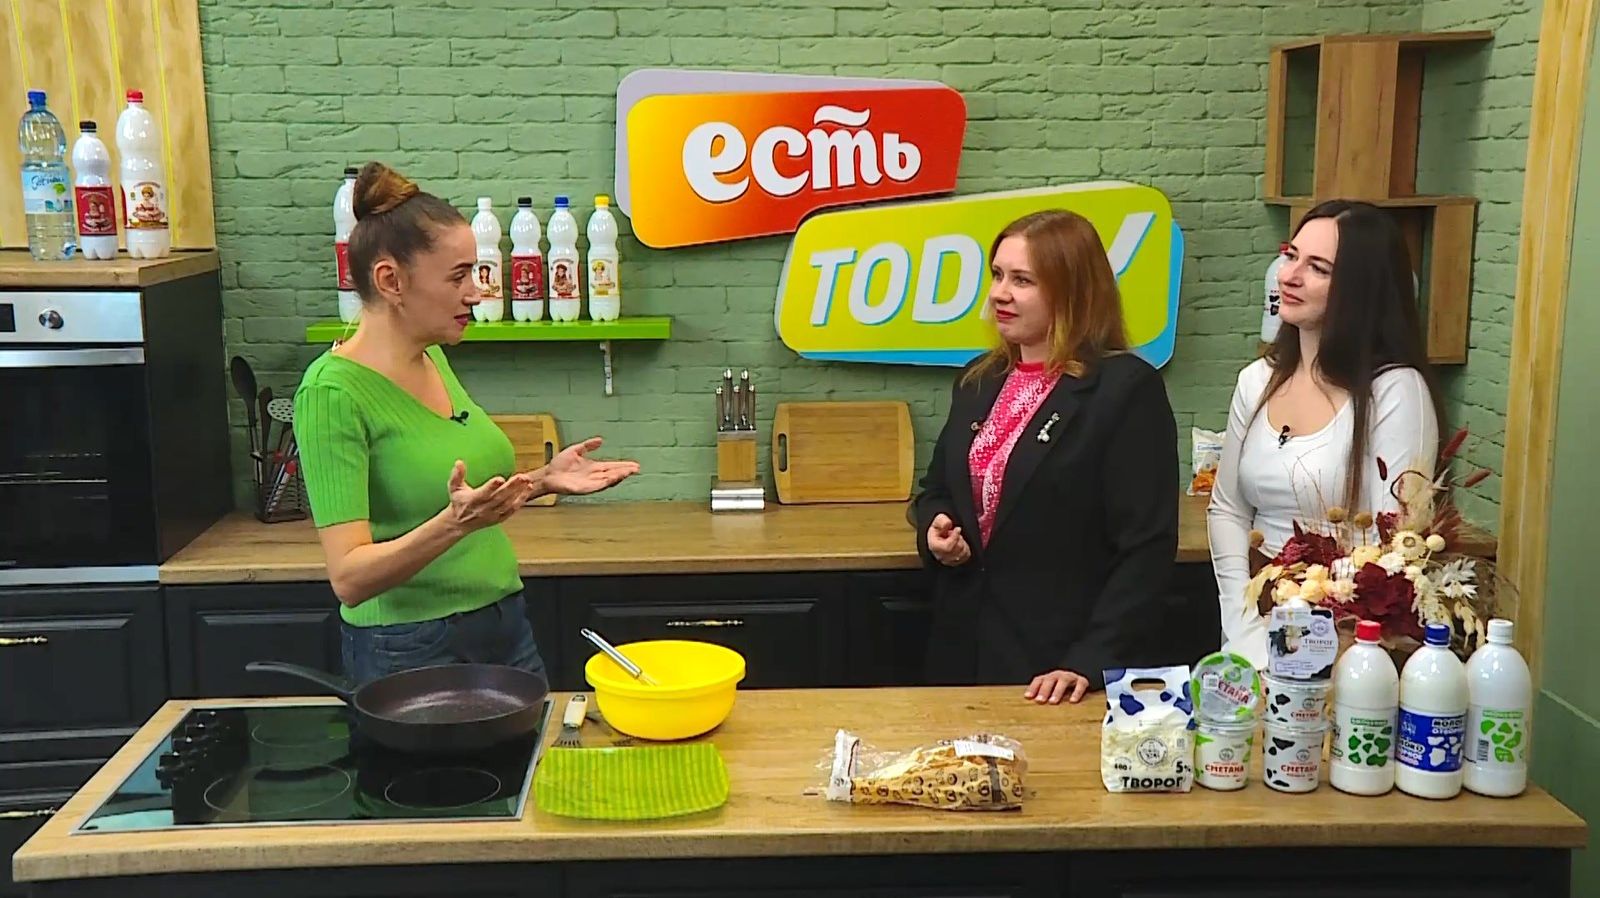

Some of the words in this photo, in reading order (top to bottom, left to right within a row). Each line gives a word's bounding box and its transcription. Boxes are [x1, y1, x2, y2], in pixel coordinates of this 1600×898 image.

[682, 105, 922, 203] есть
[810, 212, 1157, 328] TOD
[1121, 776, 1183, 789] ТВОРОГ
[1204, 764, 1245, 773] СМЕТАНА
